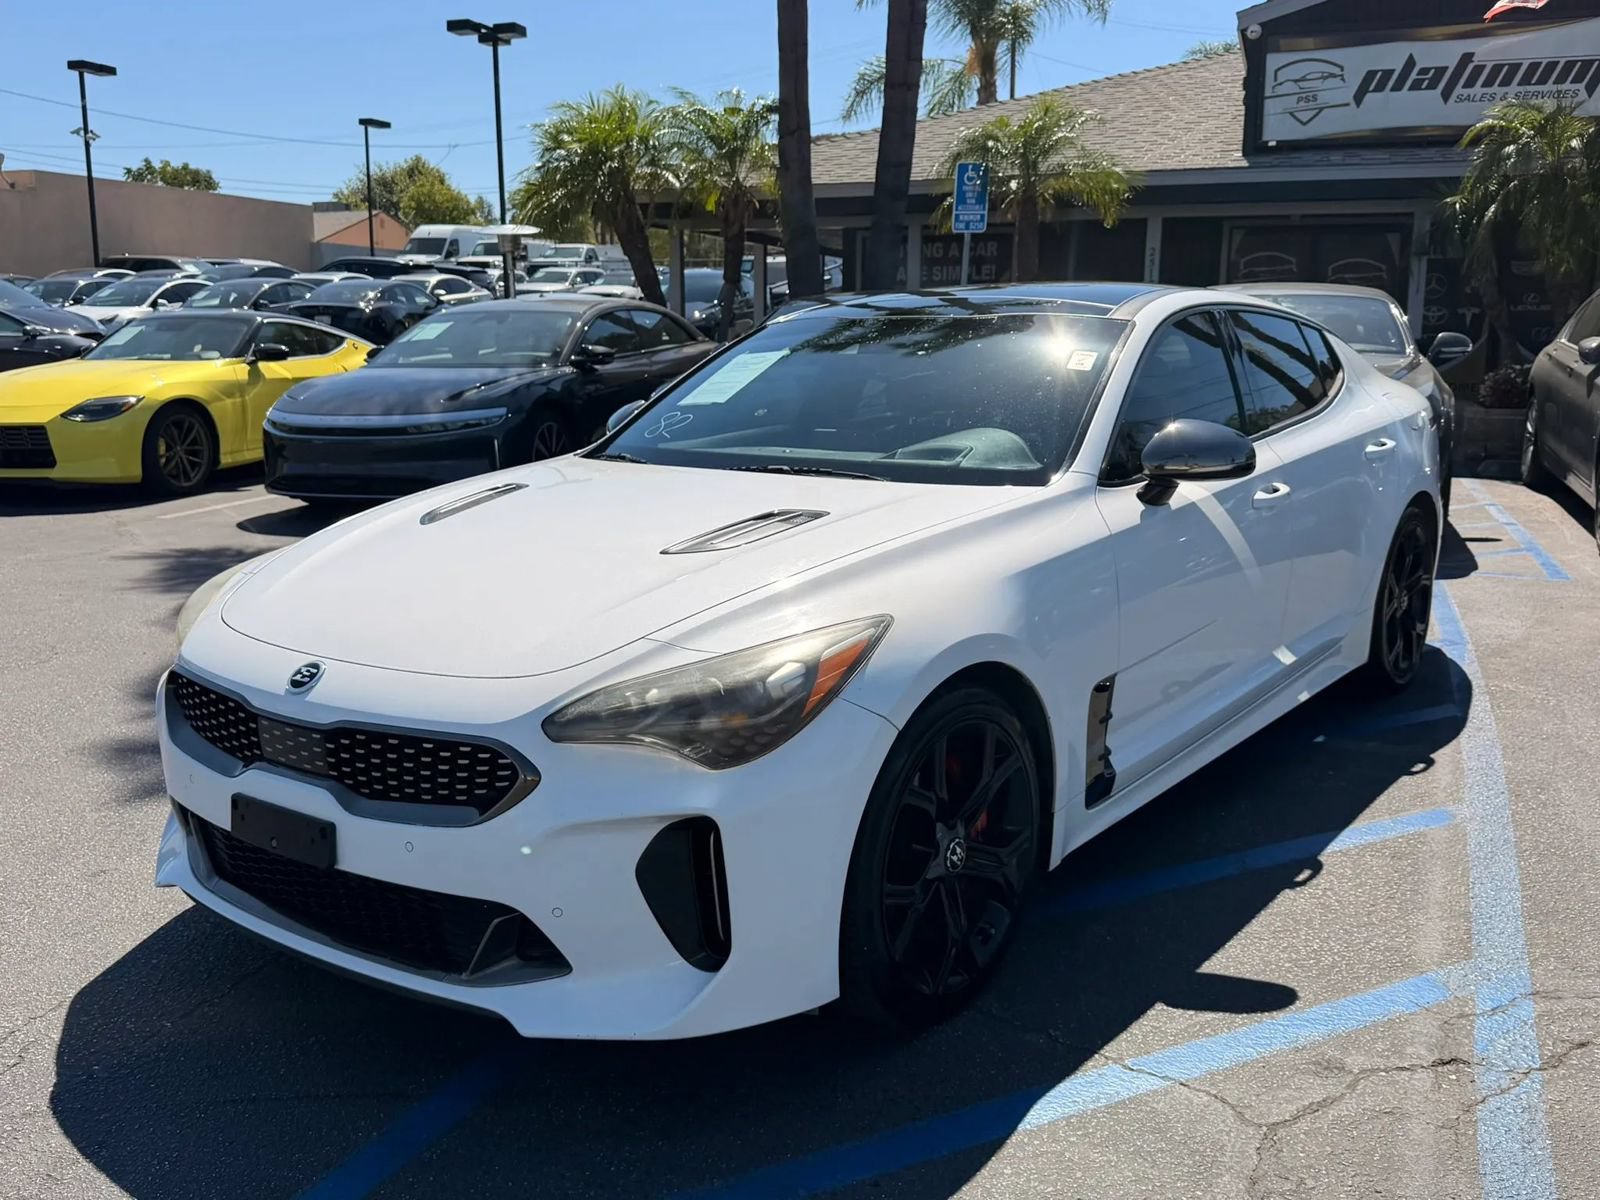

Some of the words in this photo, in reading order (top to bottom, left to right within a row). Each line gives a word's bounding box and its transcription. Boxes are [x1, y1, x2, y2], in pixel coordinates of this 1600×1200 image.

[1352, 52, 1600, 109] platinum
[1296, 93, 1318, 105] PSS
[1454, 92, 1496, 104] SALES
[1499, 91, 1509, 102] &
[1514, 88, 1580, 101] SERVICES
[931, 264, 997, 281] SIMLE!
